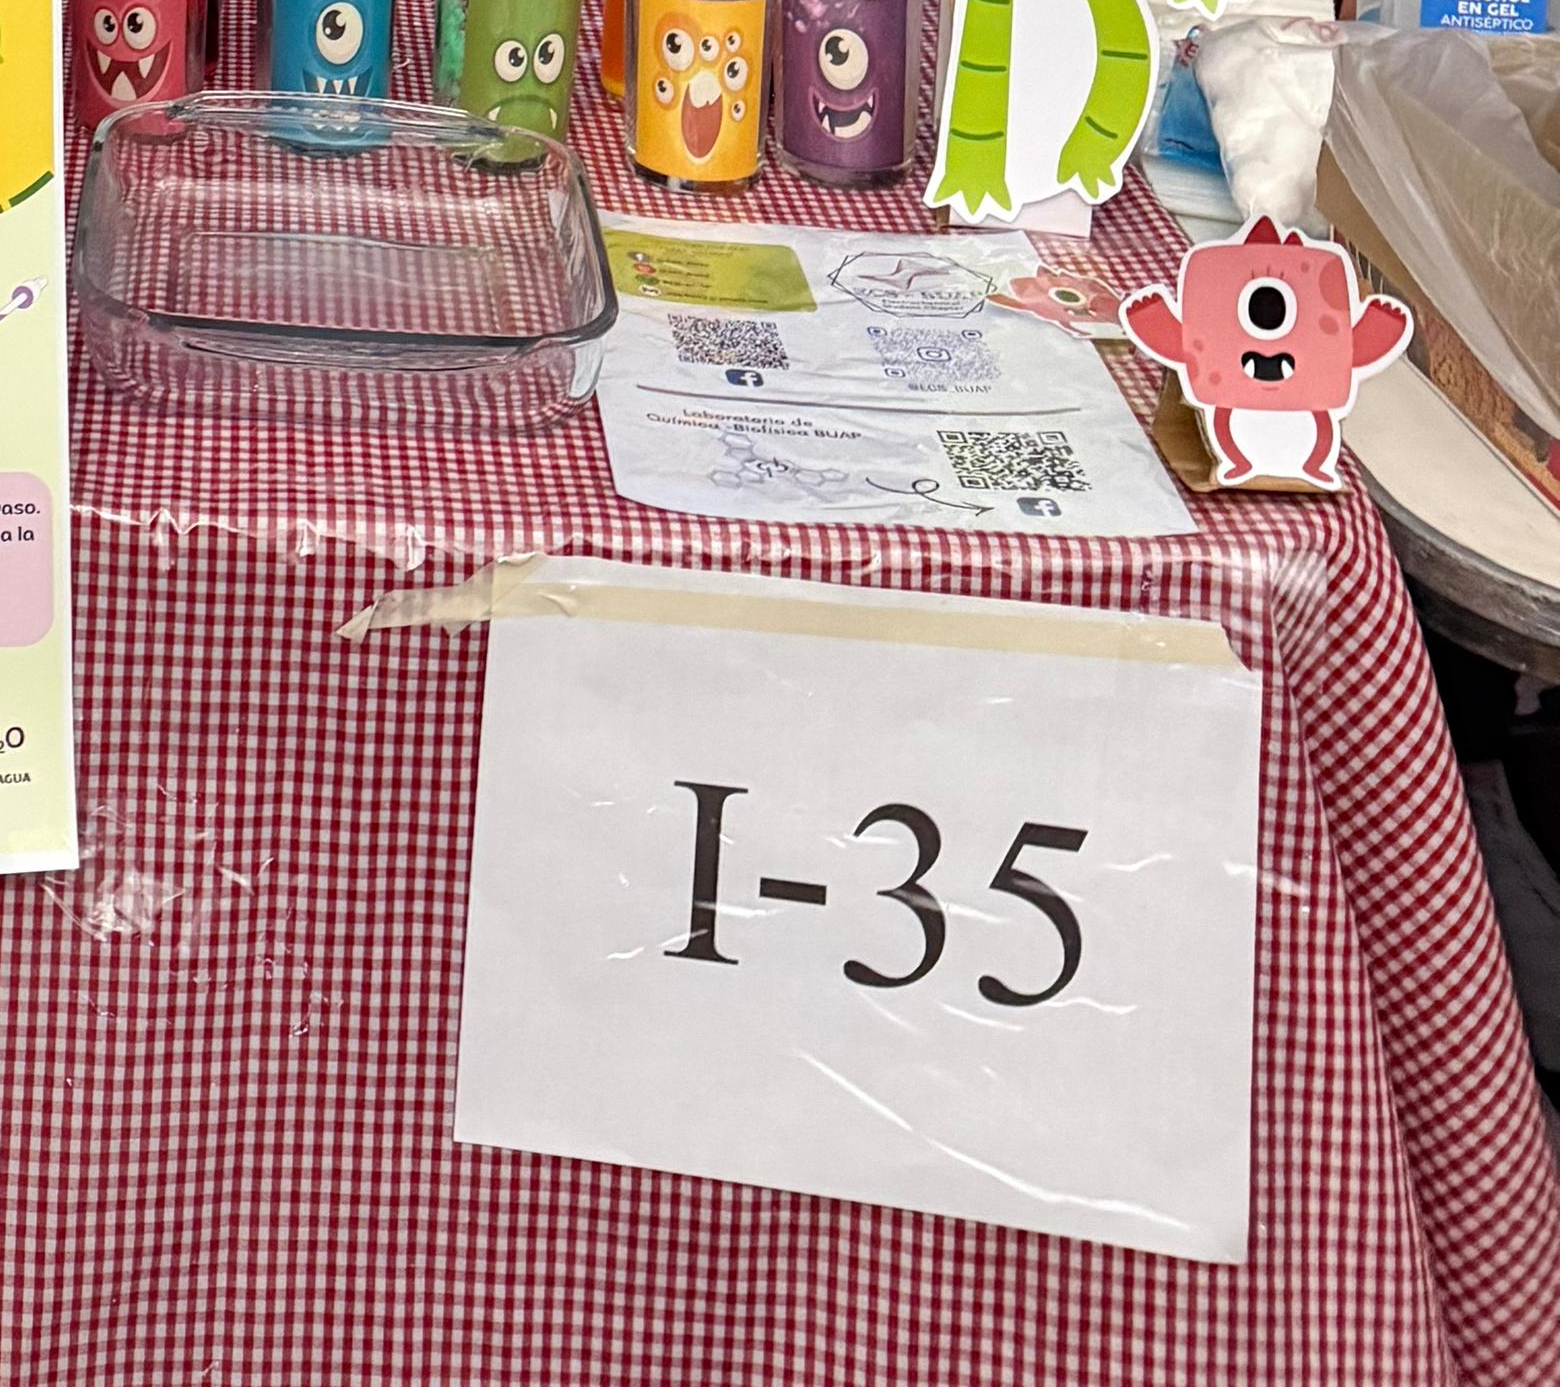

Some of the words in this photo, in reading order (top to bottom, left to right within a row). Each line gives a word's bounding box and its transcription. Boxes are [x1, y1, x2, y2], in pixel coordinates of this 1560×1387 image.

[1457, 1, 1482, 15] EN
[1487, 3, 1520, 17] GEL
[1440, 14, 1534, 31] ANTISÉPTICO
[646, 413, 720, 430] Química
[813, 430, 862, 440] BUAP
[682, 408, 785, 425] Laboratorio
[791, 417, 814, 428] de
[0, 530, 12, 542] a
[17, 525, 34, 541] la
[663, 780, 1089, 1008] I-35
